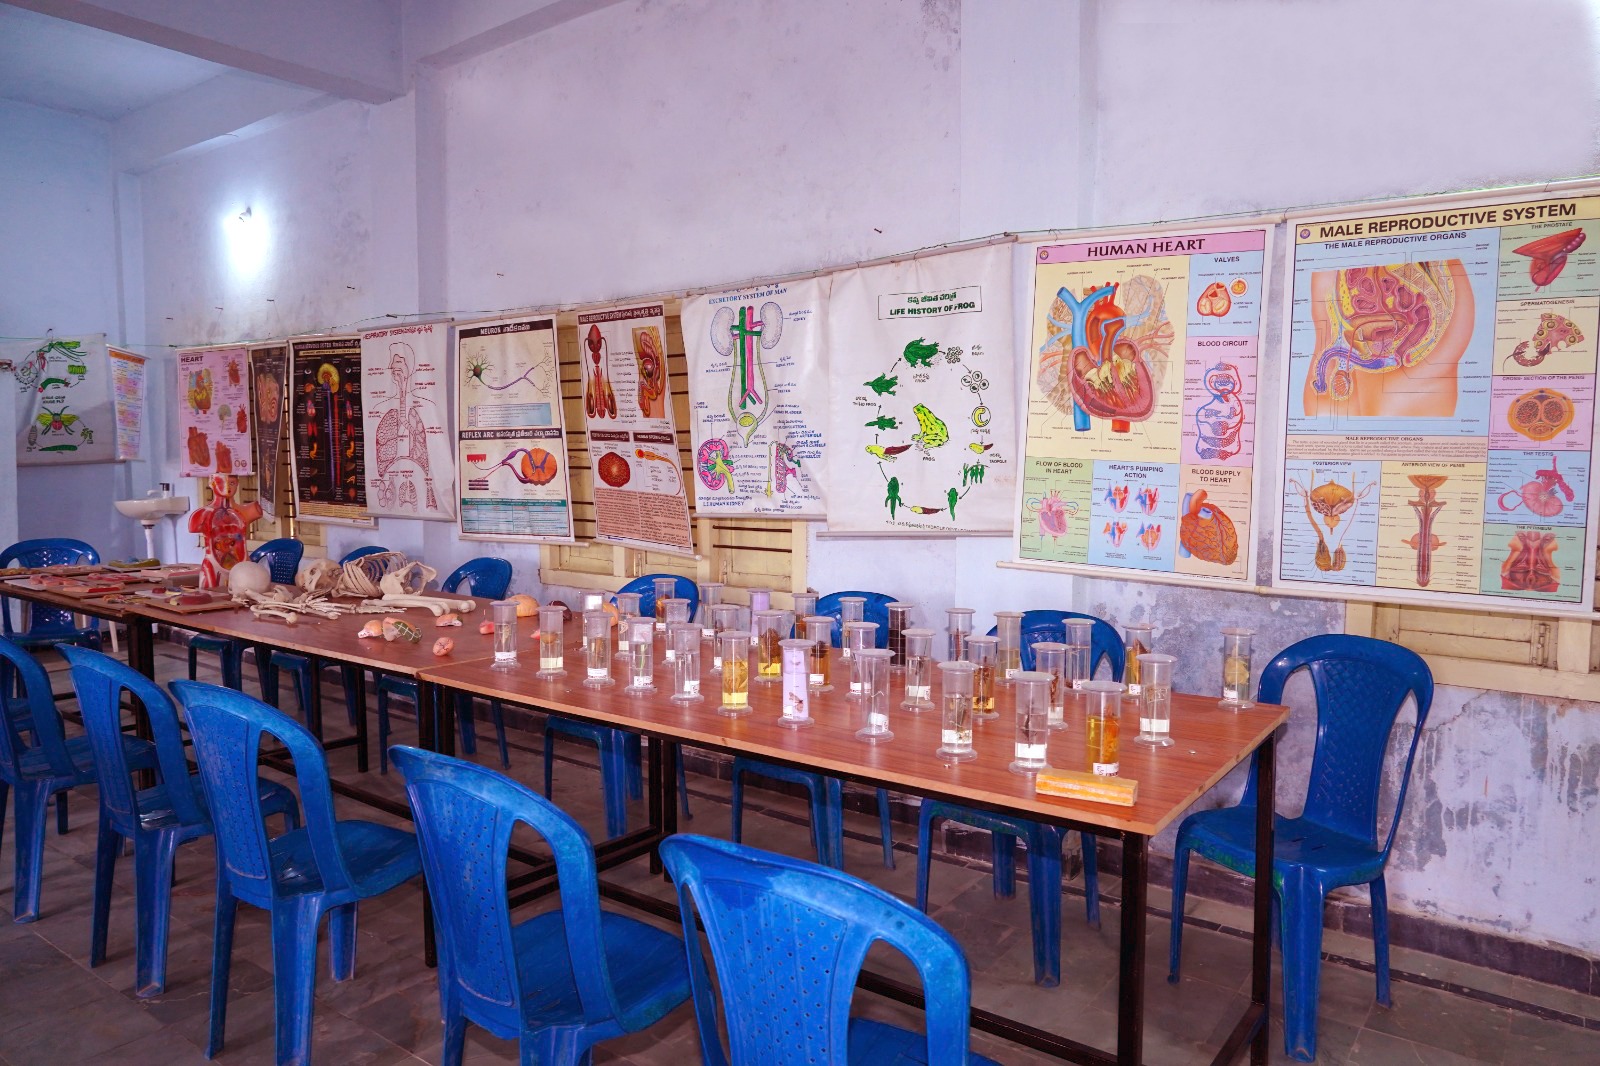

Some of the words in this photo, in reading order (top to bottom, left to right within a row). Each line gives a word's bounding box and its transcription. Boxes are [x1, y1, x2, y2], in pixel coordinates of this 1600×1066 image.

[1320, 224, 1363, 238] MALE
[1368, 210, 1497, 234] REPRODUCTIVE
[1503, 204, 1576, 221] SYSTEM
[1364, 235, 1428, 247] REPRODUCTIVE
[1430, 232, 1467, 241] ORGANS
[1088, 242, 1148, 257] HUMAN
[1152, 238, 1206, 253] HEART
[708, 295, 741, 304] EXCRETORY
[907, 306, 942, 315] HISTORY
[954, 302, 975, 310] FROG
